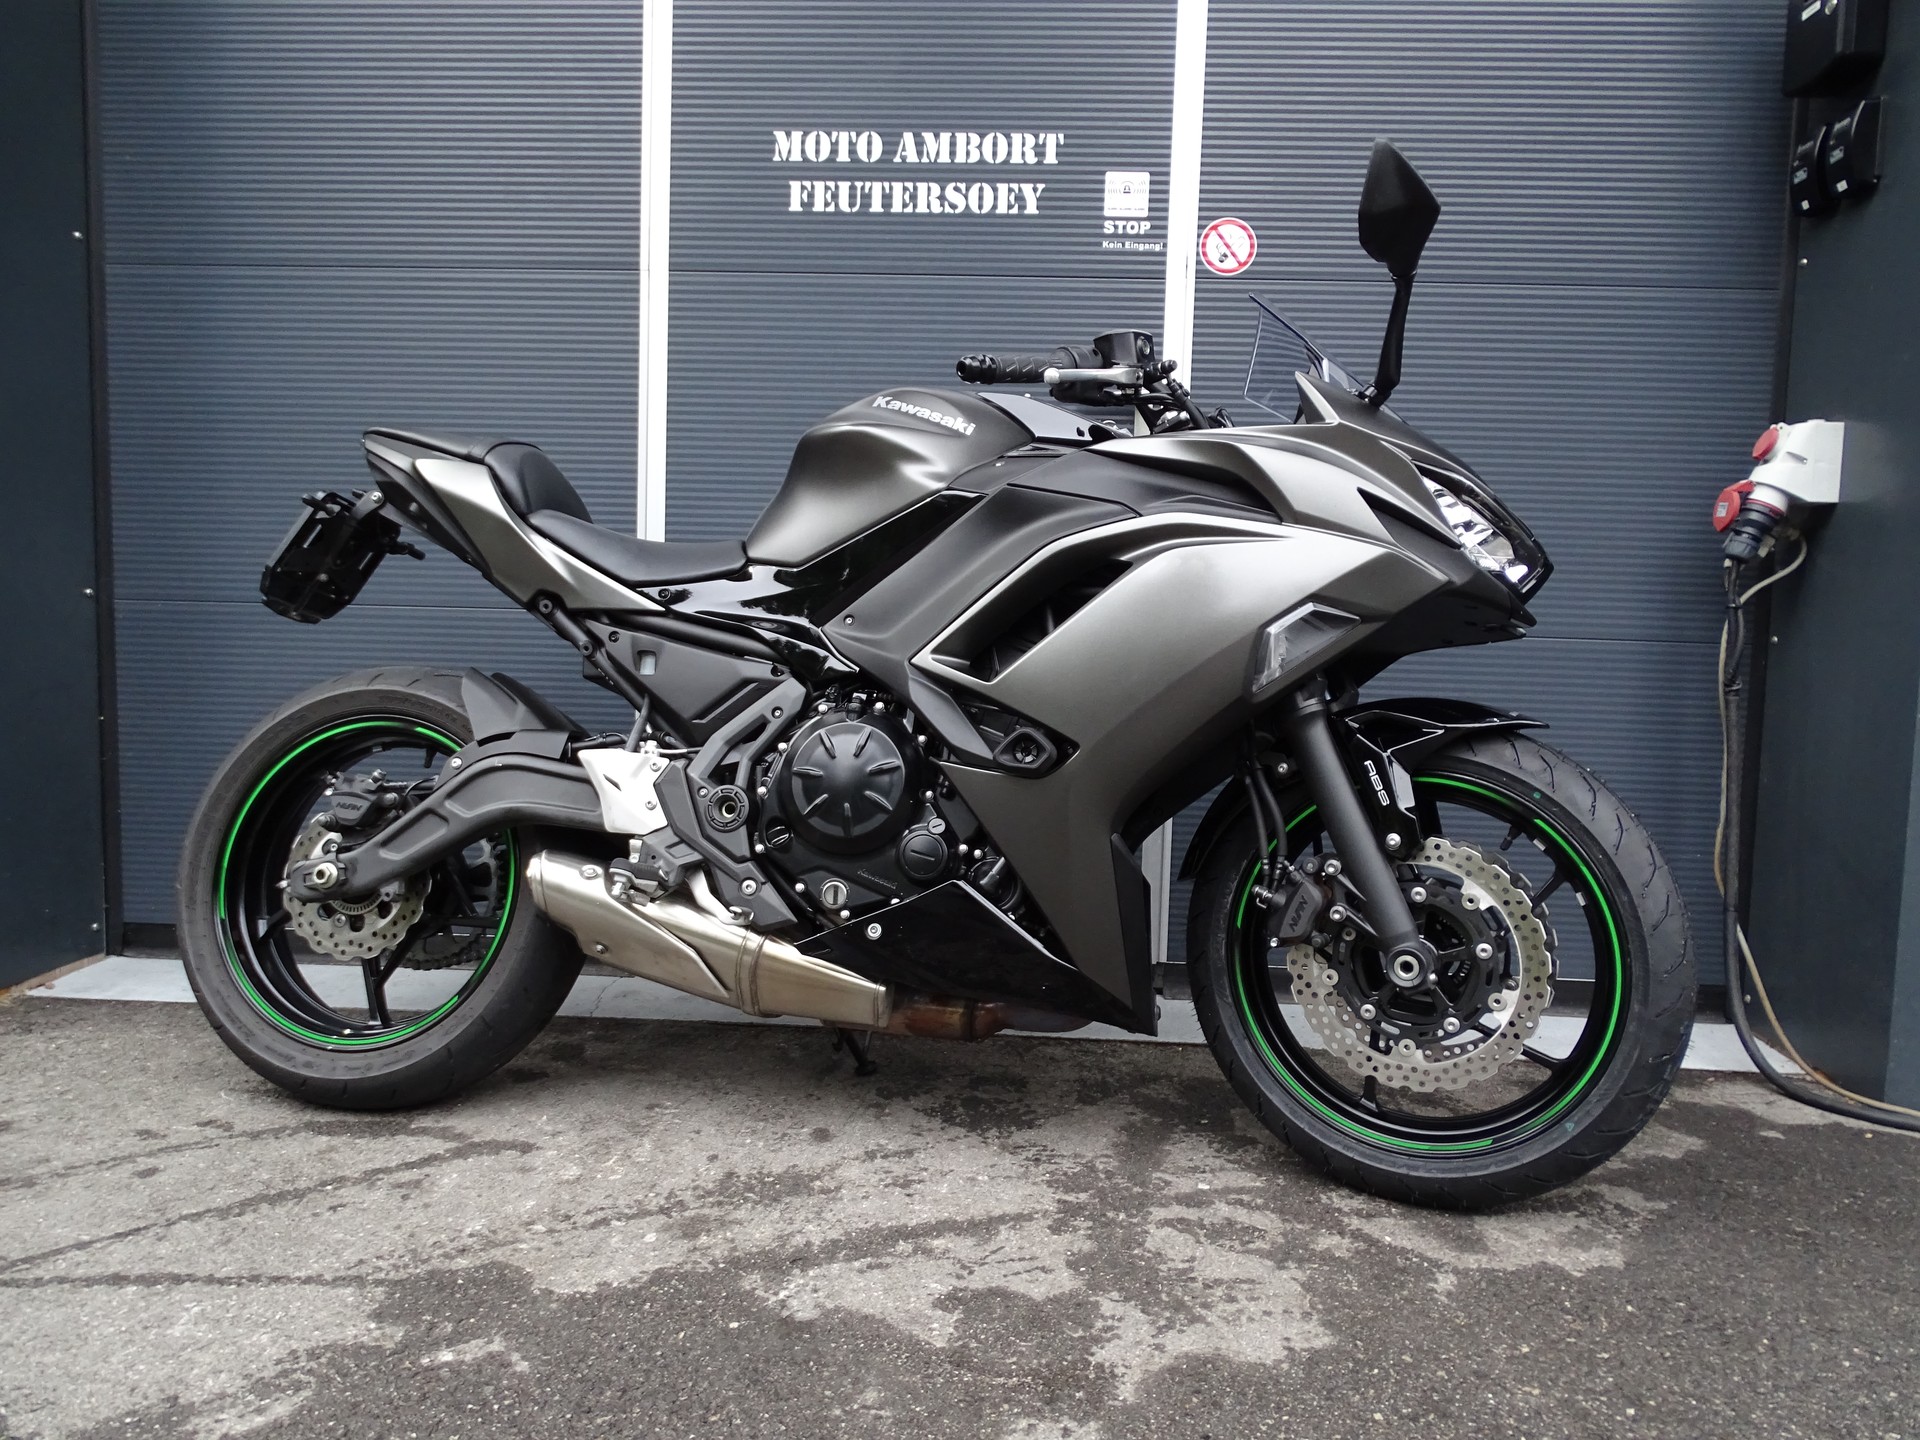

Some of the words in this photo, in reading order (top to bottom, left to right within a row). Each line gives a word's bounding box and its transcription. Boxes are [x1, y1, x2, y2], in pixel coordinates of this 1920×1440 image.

[772, 130, 884, 163] MOTO
[892, 131, 1065, 165] AMBORT
[788, 180, 1046, 215] FEUTERSOEY
[1103, 220, 1151, 235] STOP
[1102, 240, 1123, 249] Kein
[1125, 241, 1163, 252] Eingang!
[872, 395, 976, 436] Kawasaki
[1363, 759, 1391, 807] ABS
